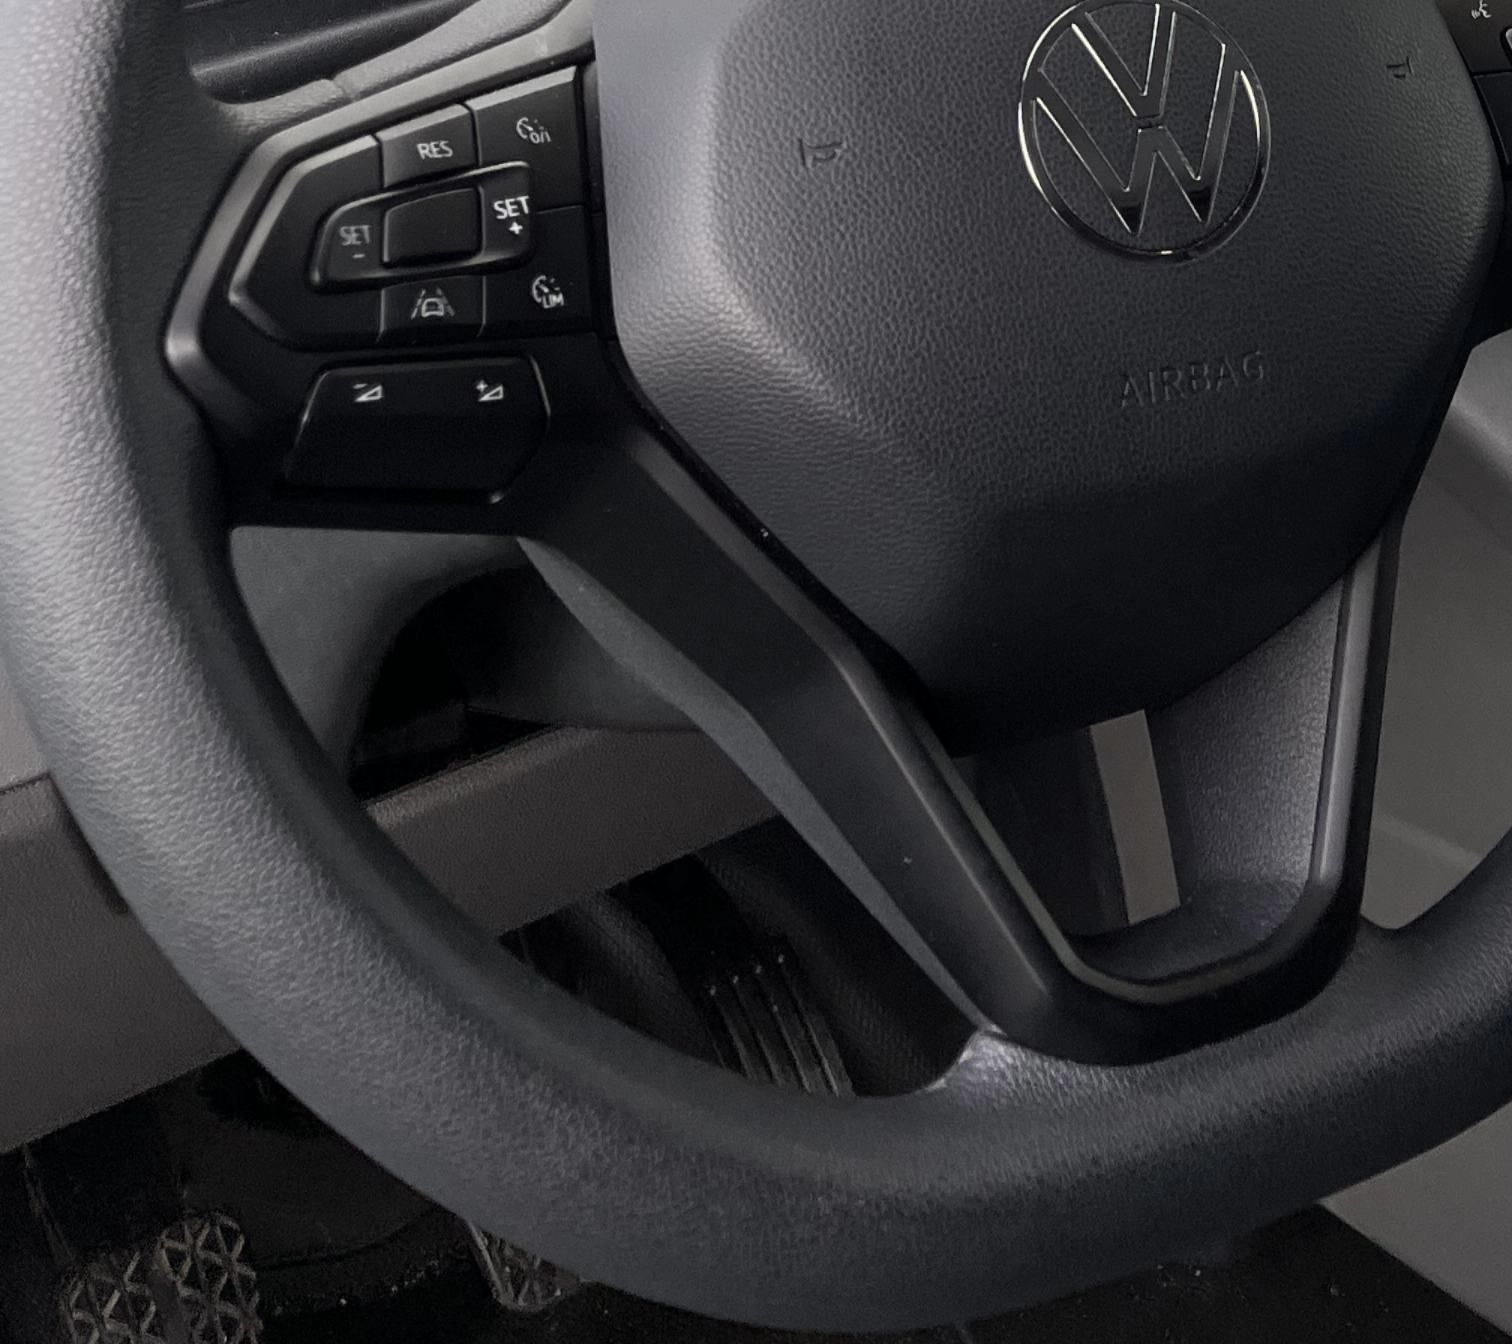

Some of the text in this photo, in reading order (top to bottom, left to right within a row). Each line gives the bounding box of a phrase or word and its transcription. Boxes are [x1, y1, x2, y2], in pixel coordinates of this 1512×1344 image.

[416, 139, 454, 160] RES
[493, 195, 530, 220] SET
[339, 224, 372, 247] SET
[1119, 349, 1265, 409] AIRBAG
